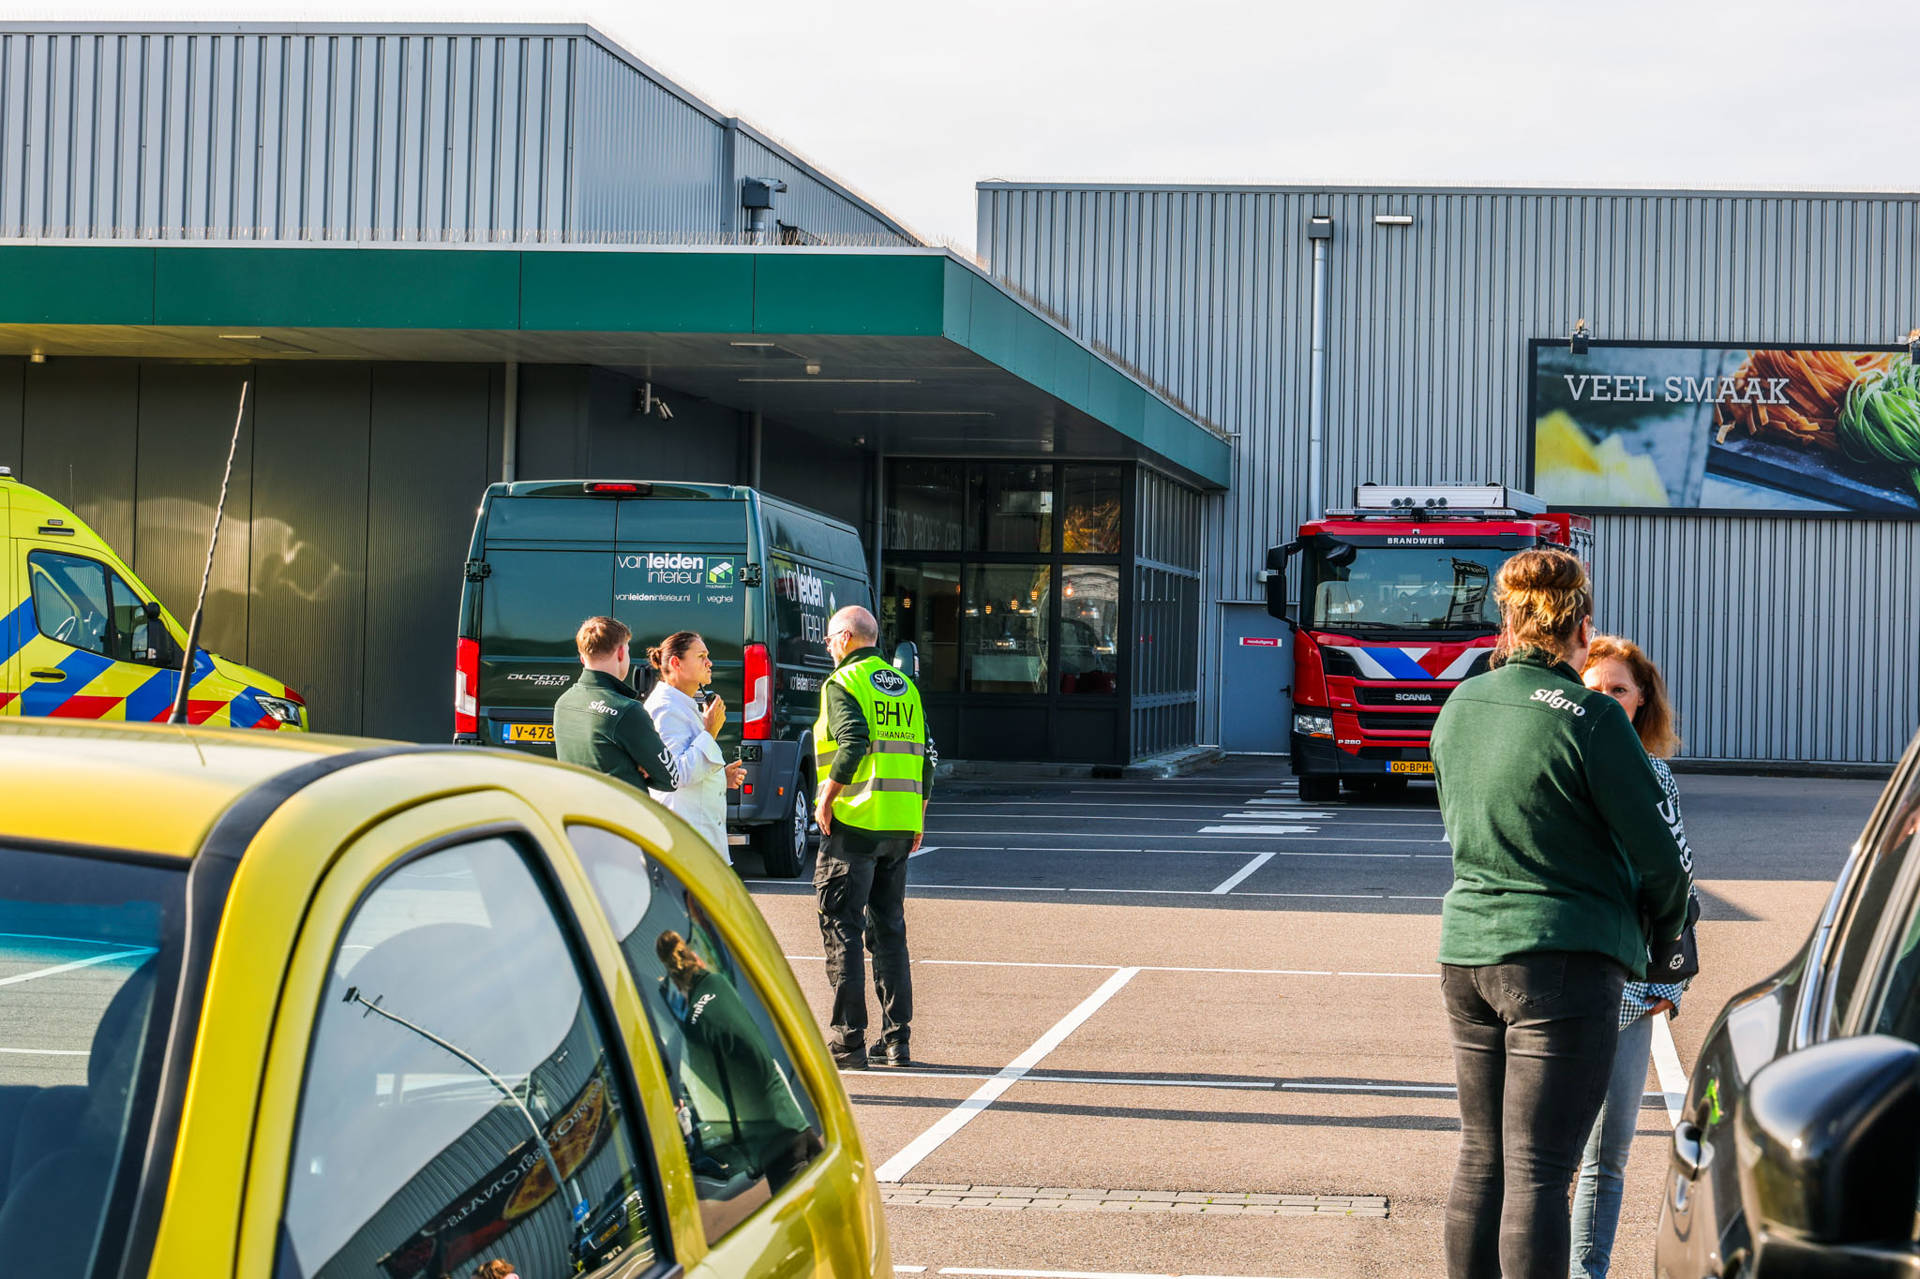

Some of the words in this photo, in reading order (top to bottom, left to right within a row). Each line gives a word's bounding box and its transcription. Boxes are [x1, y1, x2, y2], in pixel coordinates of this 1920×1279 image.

[1563, 374, 1654, 402] VEEL
[1665, 376, 1790, 404] SMAAK
[1387, 537, 1445, 545] BRANDWEER
[617, 553, 703, 570] vanleiden
[648, 569, 703, 584] interieur
[615, 593, 691, 603] vanleideninterieur.nl
[706, 595, 734, 604] veghel
[507, 673, 570, 681] DUCATO
[874, 670, 903, 687] Sligro
[1395, 693, 1432, 701] SCANIA
[1529, 688, 1586, 717] Sligro
[588, 700, 618, 716] Sligro
[874, 700, 914, 728] BHV
[515, 725, 555, 739] V-478
[657, 747, 680, 789] Slig
[1392, 762, 1433, 772] 00-BPH-
[1656, 798, 1693, 880] Slig
